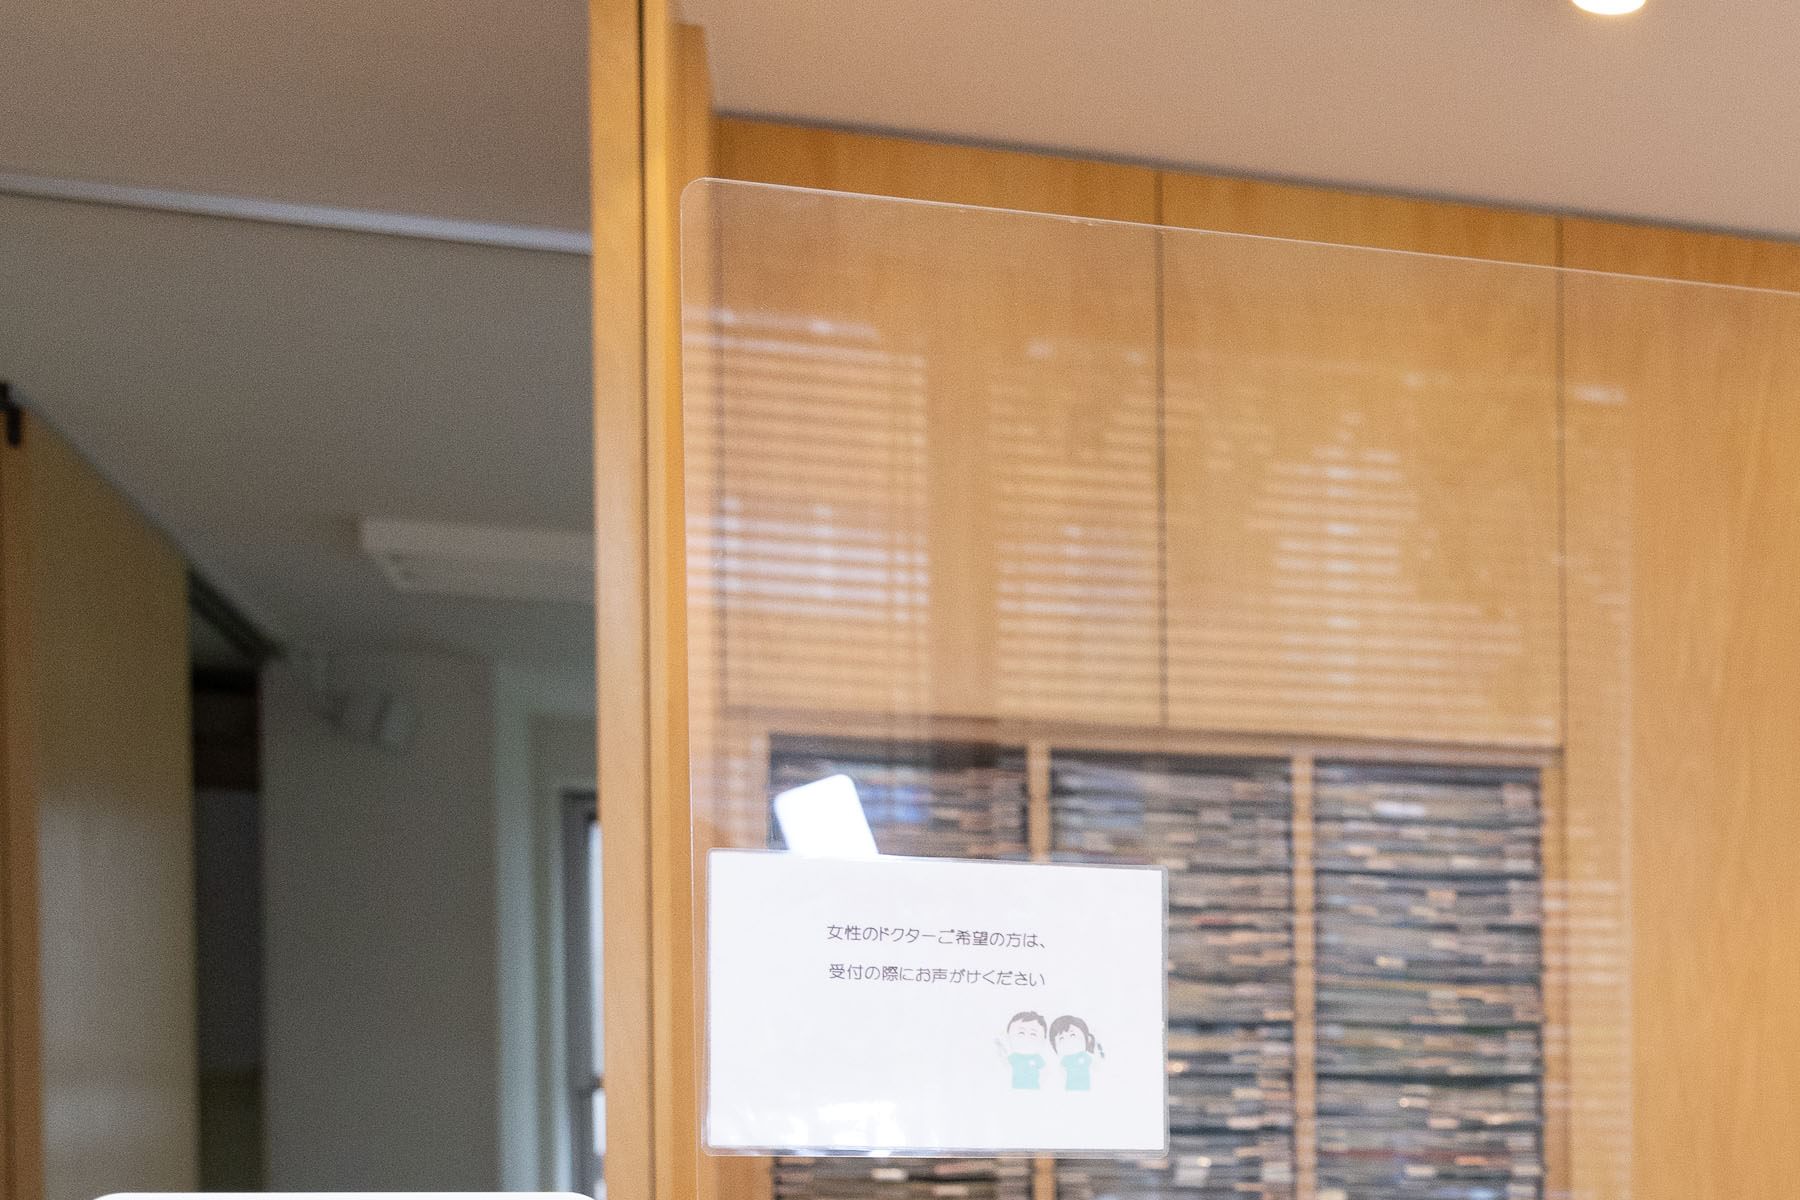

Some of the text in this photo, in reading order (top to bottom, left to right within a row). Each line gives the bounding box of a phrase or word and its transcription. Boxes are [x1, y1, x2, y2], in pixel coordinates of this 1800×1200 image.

[827, 925, 1047, 949] 女性のドクターご希望の方は、
[829, 964, 1045, 987] 受付の際にお声がけください
